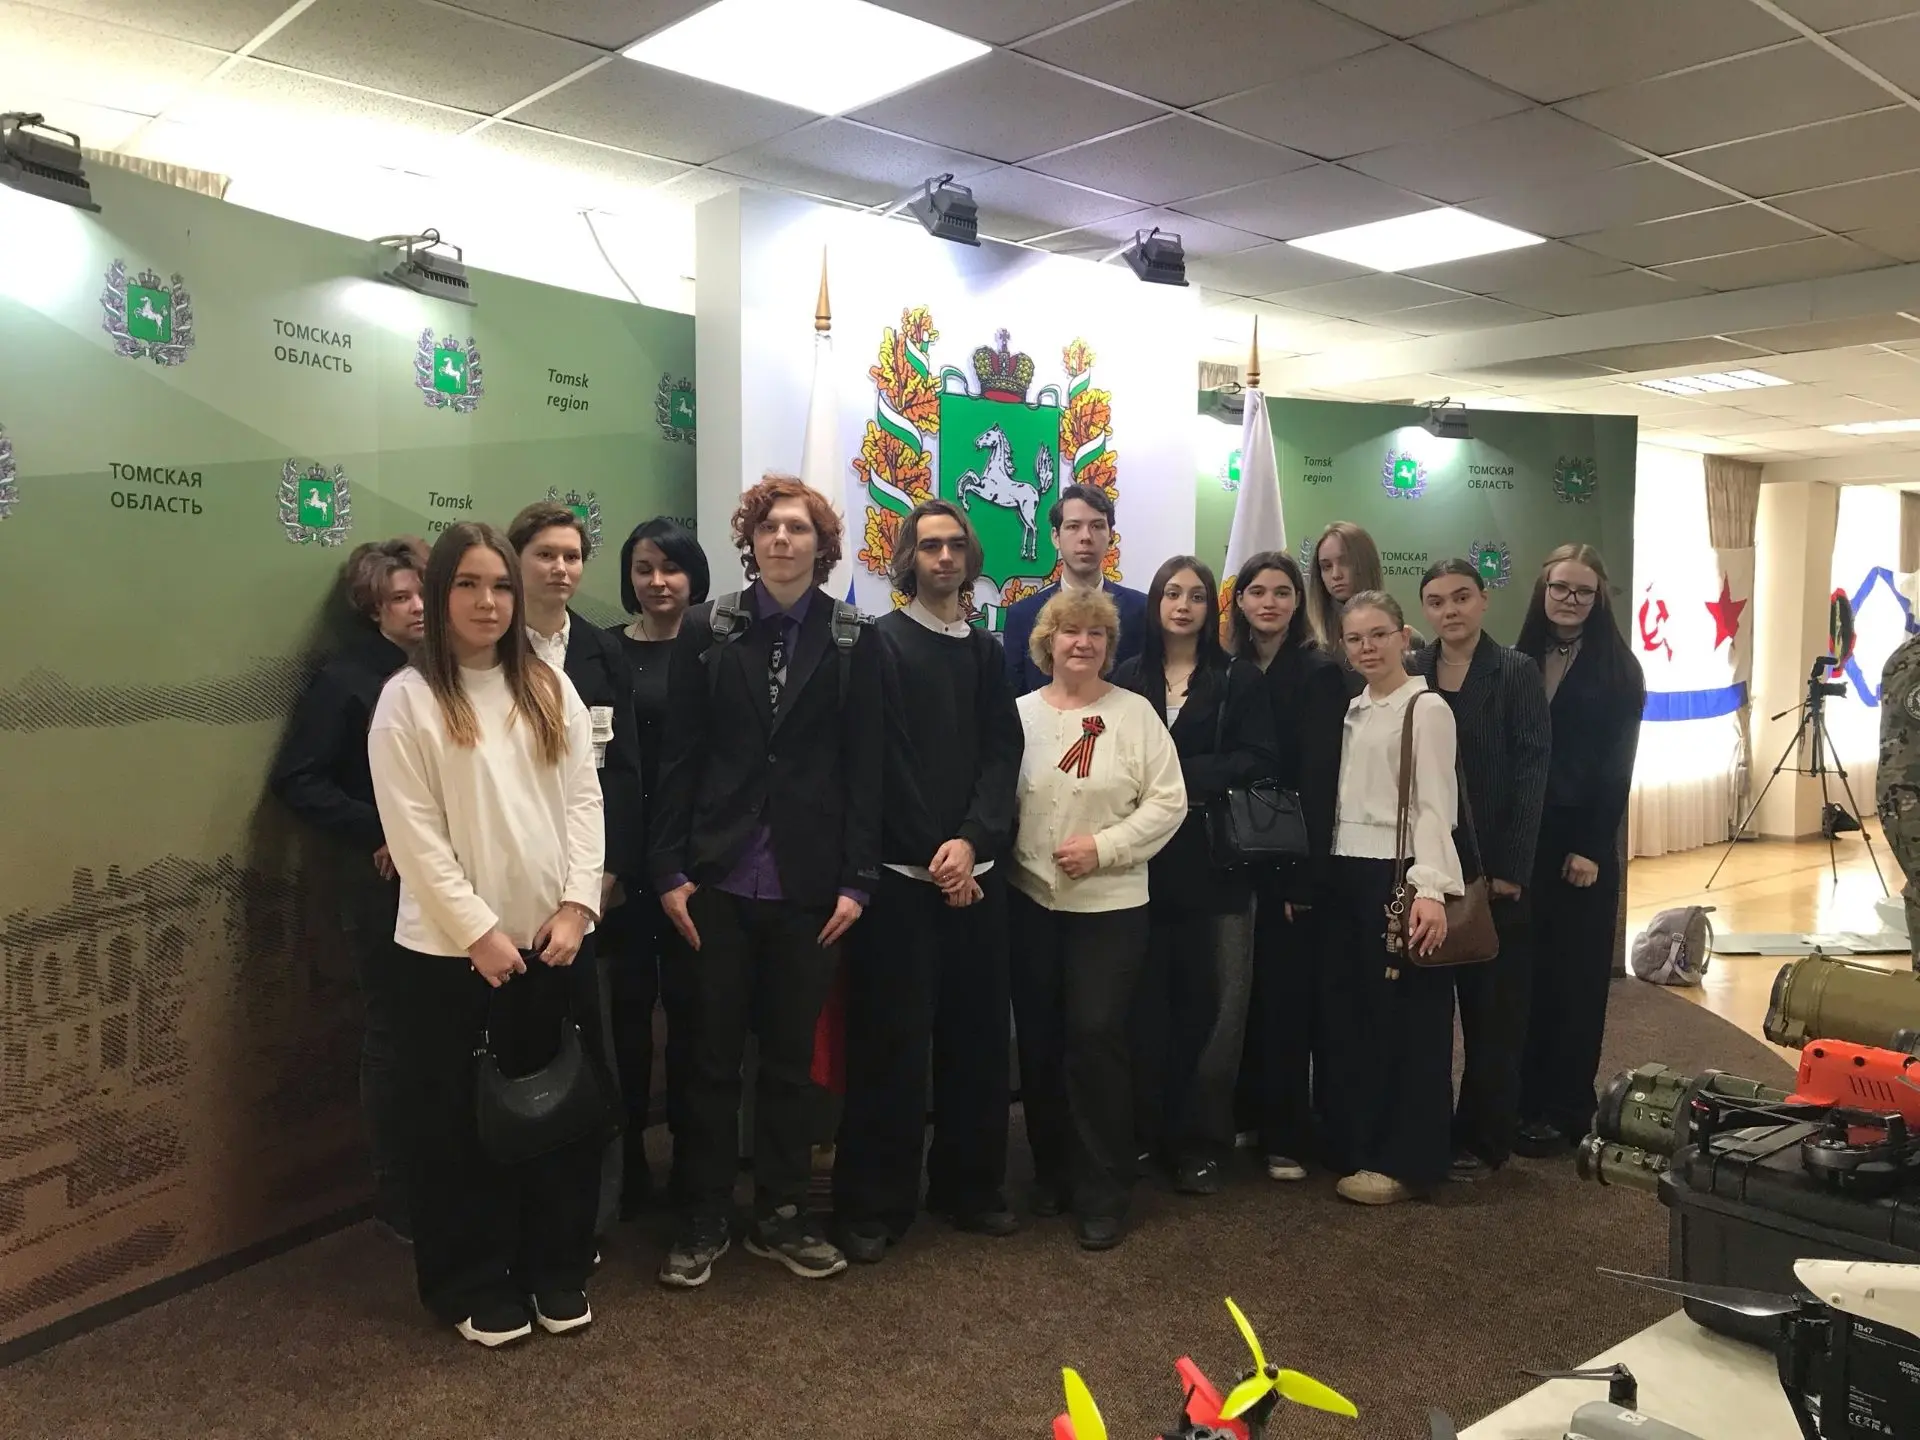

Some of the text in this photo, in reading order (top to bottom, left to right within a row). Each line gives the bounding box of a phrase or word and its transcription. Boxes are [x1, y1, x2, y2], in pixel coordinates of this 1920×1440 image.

[273, 318, 352, 349] ТОМСКАЯ
[274, 345, 353, 373] ОБЛАСТЬ
[547, 368, 589, 389] Tomsk
[547, 394, 589, 412] region
[1303, 455, 1333, 468] Tomsk
[1468, 465, 1514, 476] ТОМСКАЯ
[108, 462, 202, 488] ТОМСКАЯ
[1303, 472, 1333, 486] region
[1467, 479, 1514, 490] ОБЛАСТЬ
[110, 491, 203, 515] ОБЛАСТЬ
[428, 491, 473, 510] Tomsk
[1381, 551, 1428, 561] ТОМСКАЯ
[1852, 1322, 1873, 1334] TB47
